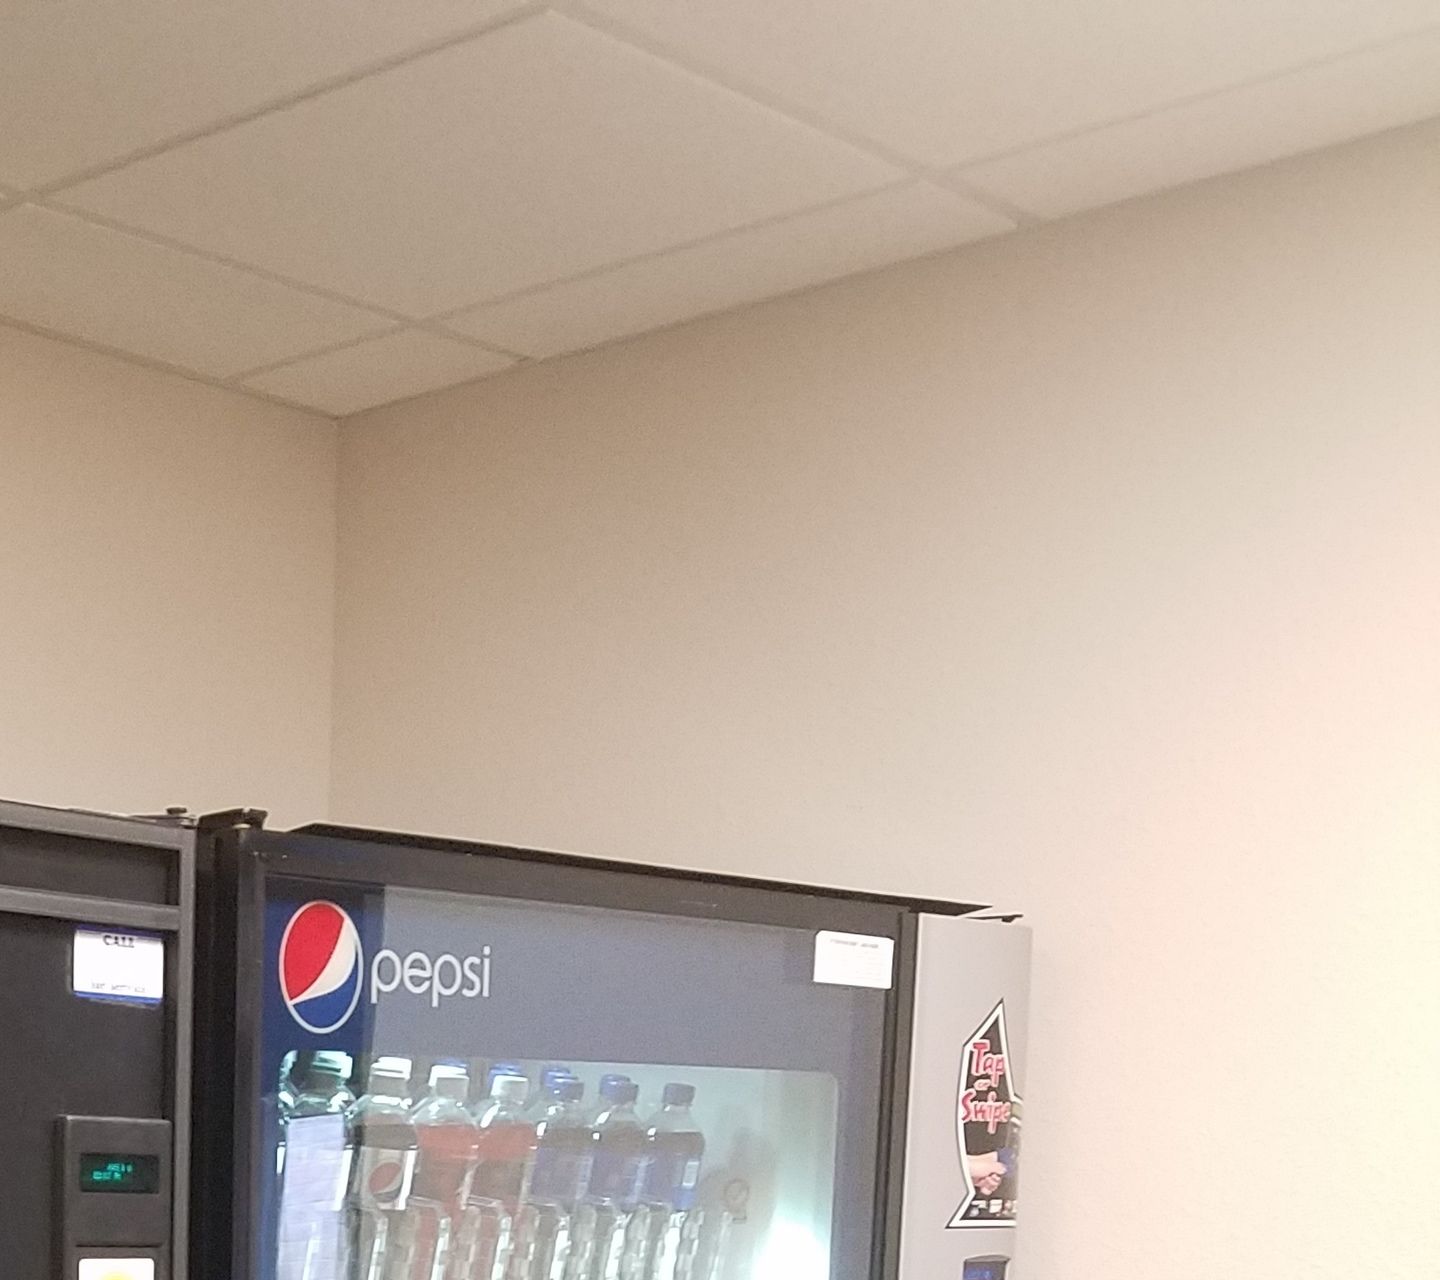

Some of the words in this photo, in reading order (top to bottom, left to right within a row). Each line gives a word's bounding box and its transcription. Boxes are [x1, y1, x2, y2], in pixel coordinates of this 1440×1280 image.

[370, 945, 491, 1008] pepsi
[971, 1040, 1006, 1086] Tap
[961, 1091, 1011, 1133] Swipe
